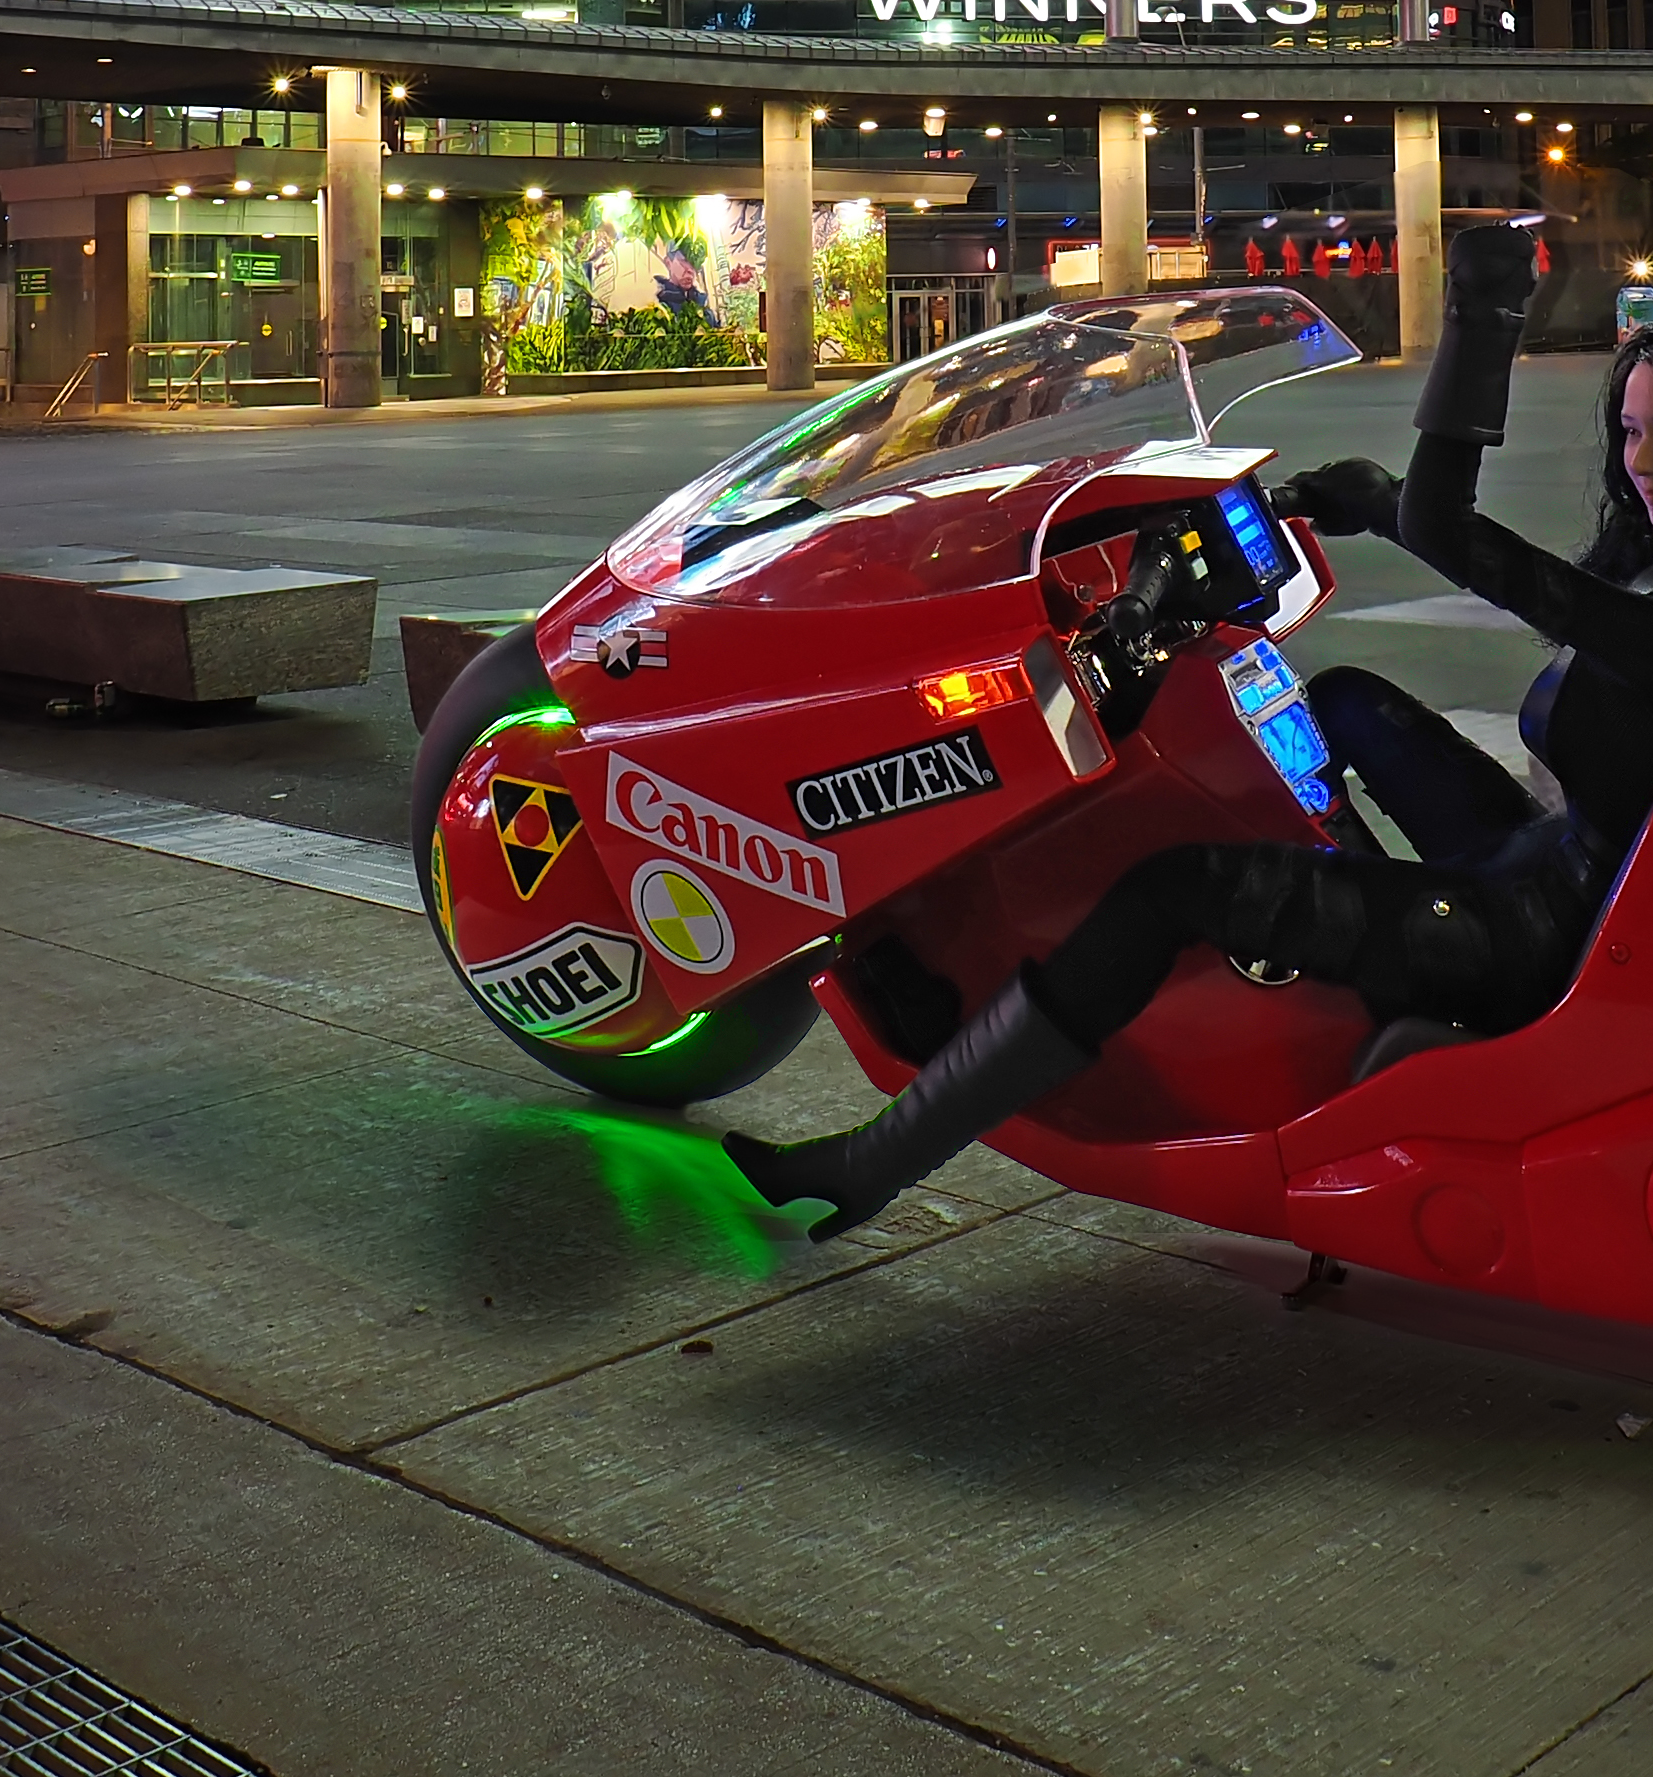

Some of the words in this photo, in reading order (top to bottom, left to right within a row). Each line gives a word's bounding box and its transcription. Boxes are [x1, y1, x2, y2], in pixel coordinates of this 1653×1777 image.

[796, 735, 986, 831] CITIZEN
[613, 768, 830, 907] Canon
[481, 942, 622, 1026] SHOEI
